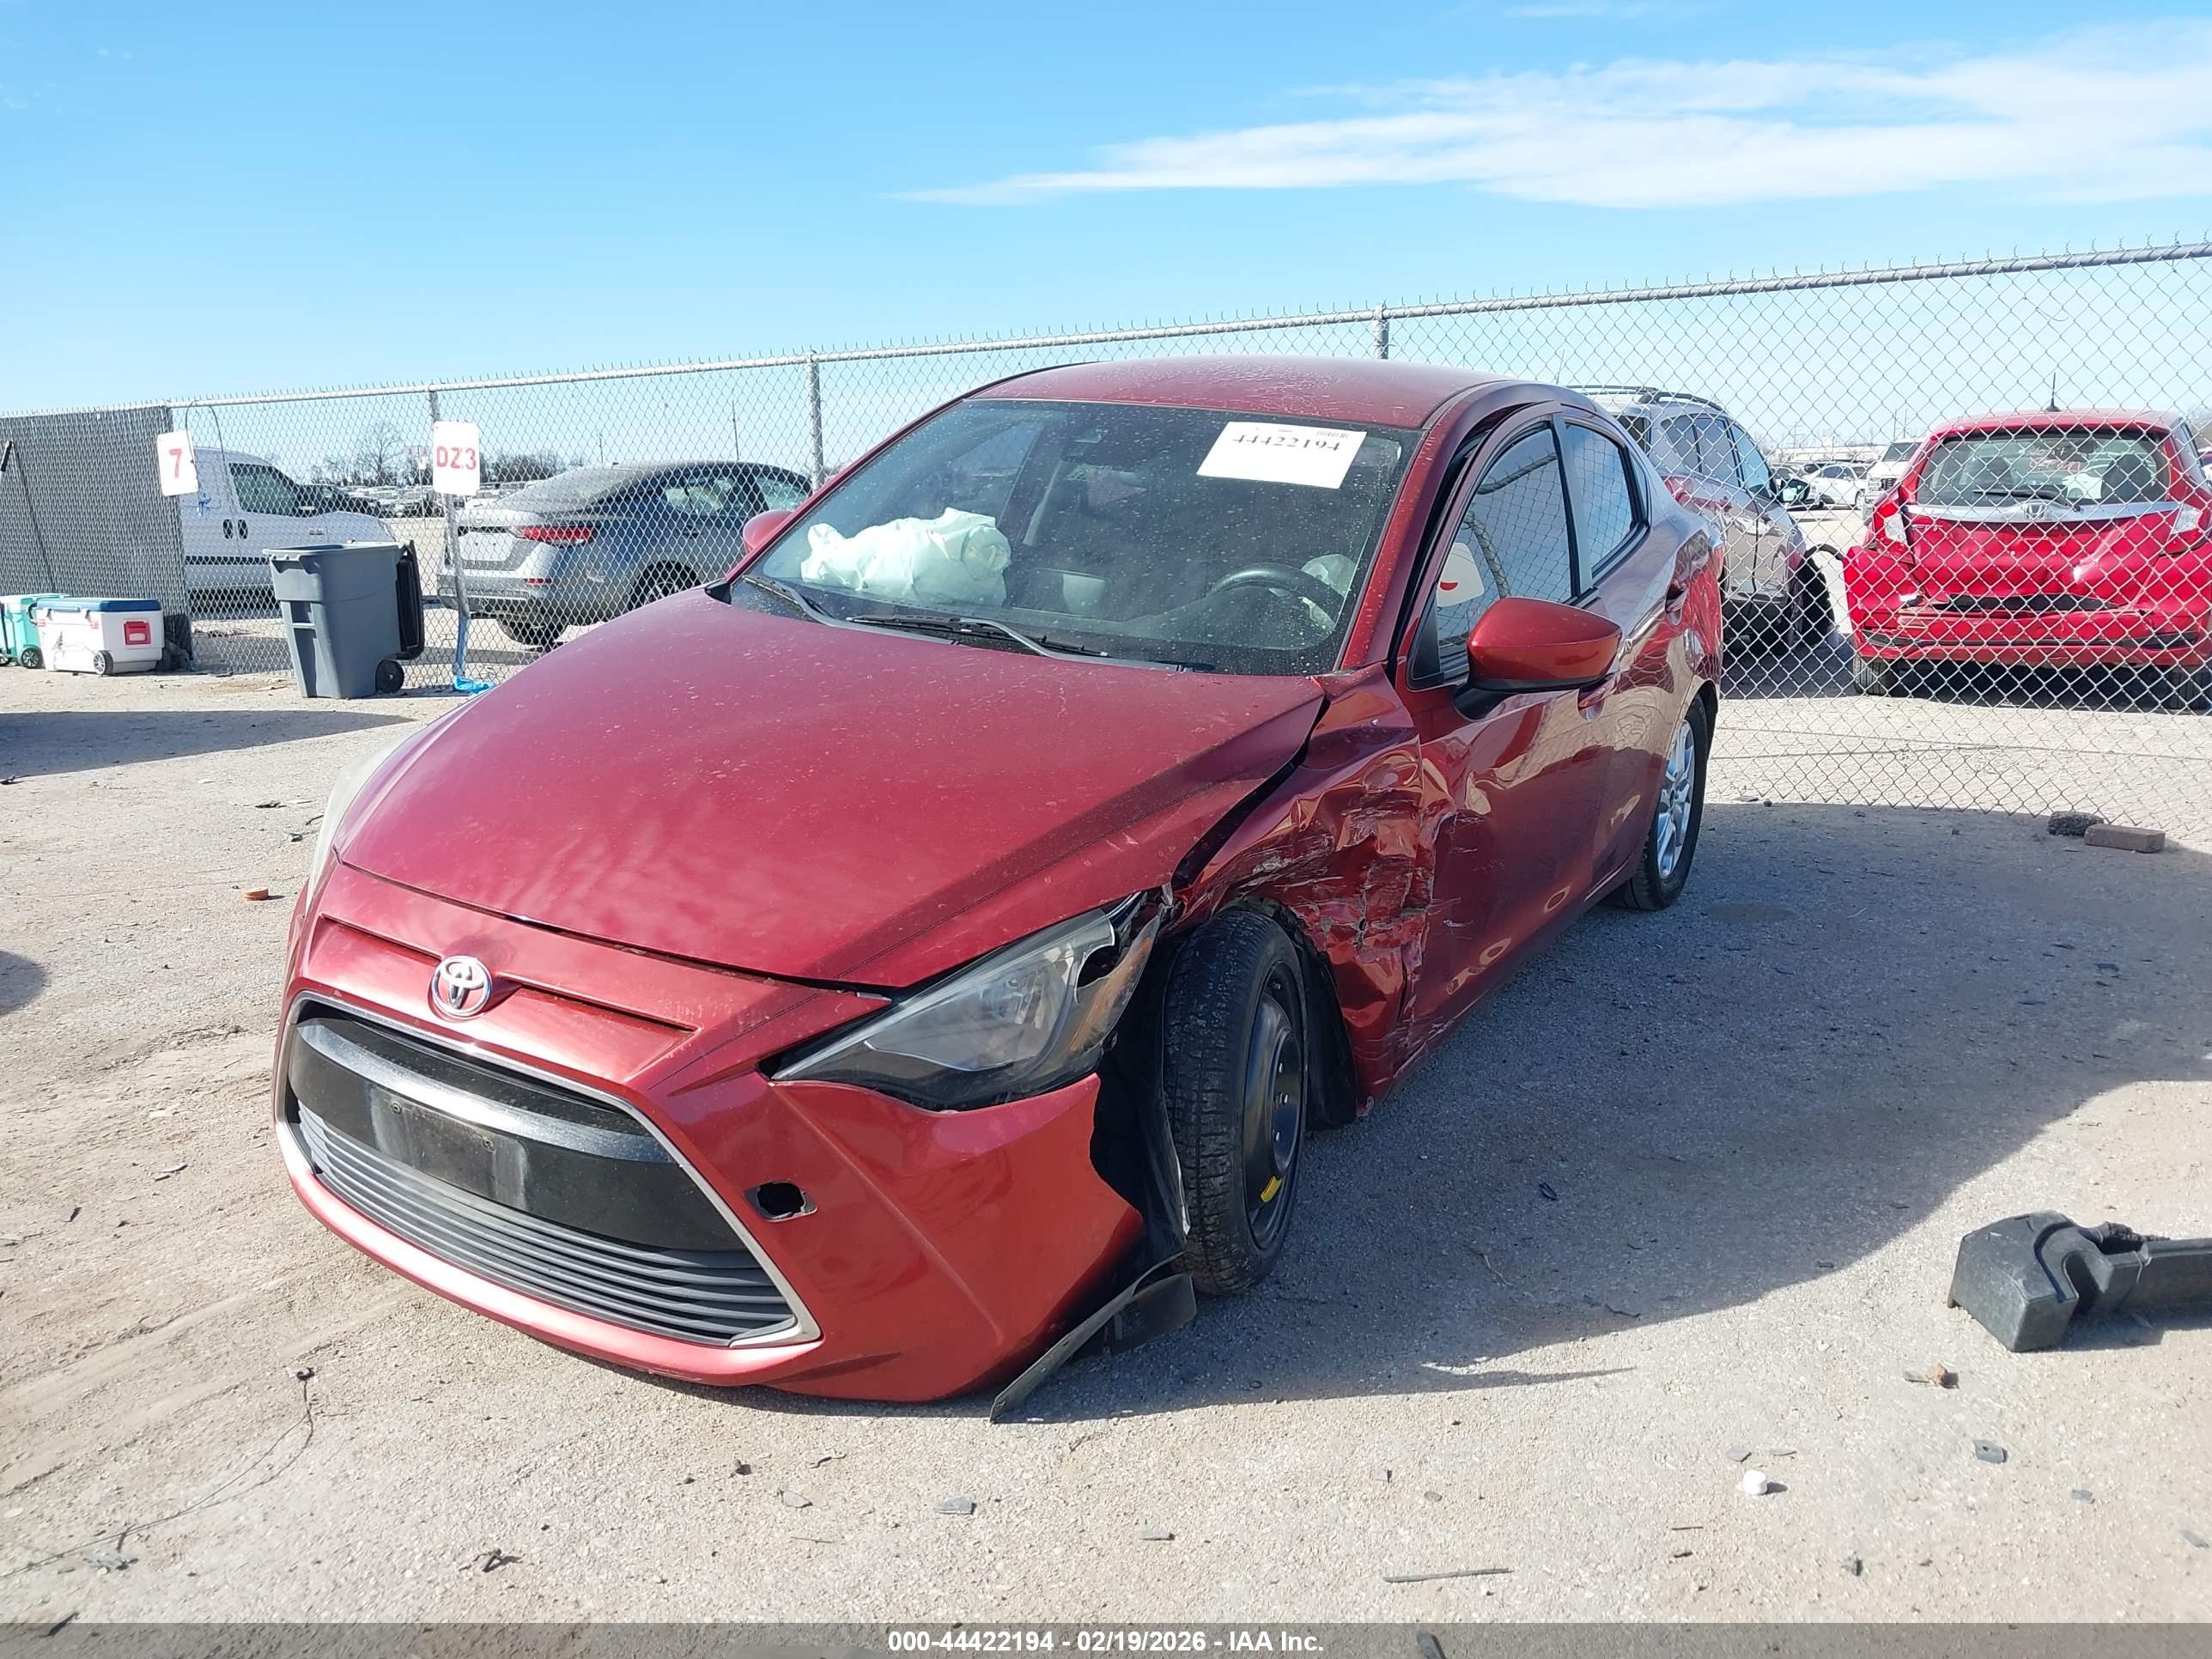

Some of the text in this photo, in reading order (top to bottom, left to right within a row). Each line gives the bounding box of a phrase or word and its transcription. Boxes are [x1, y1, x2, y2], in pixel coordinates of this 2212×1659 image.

[1232, 434, 1340, 452] 44422194
[168, 447, 183, 478] 7
[436, 446, 477, 471] DZ3
